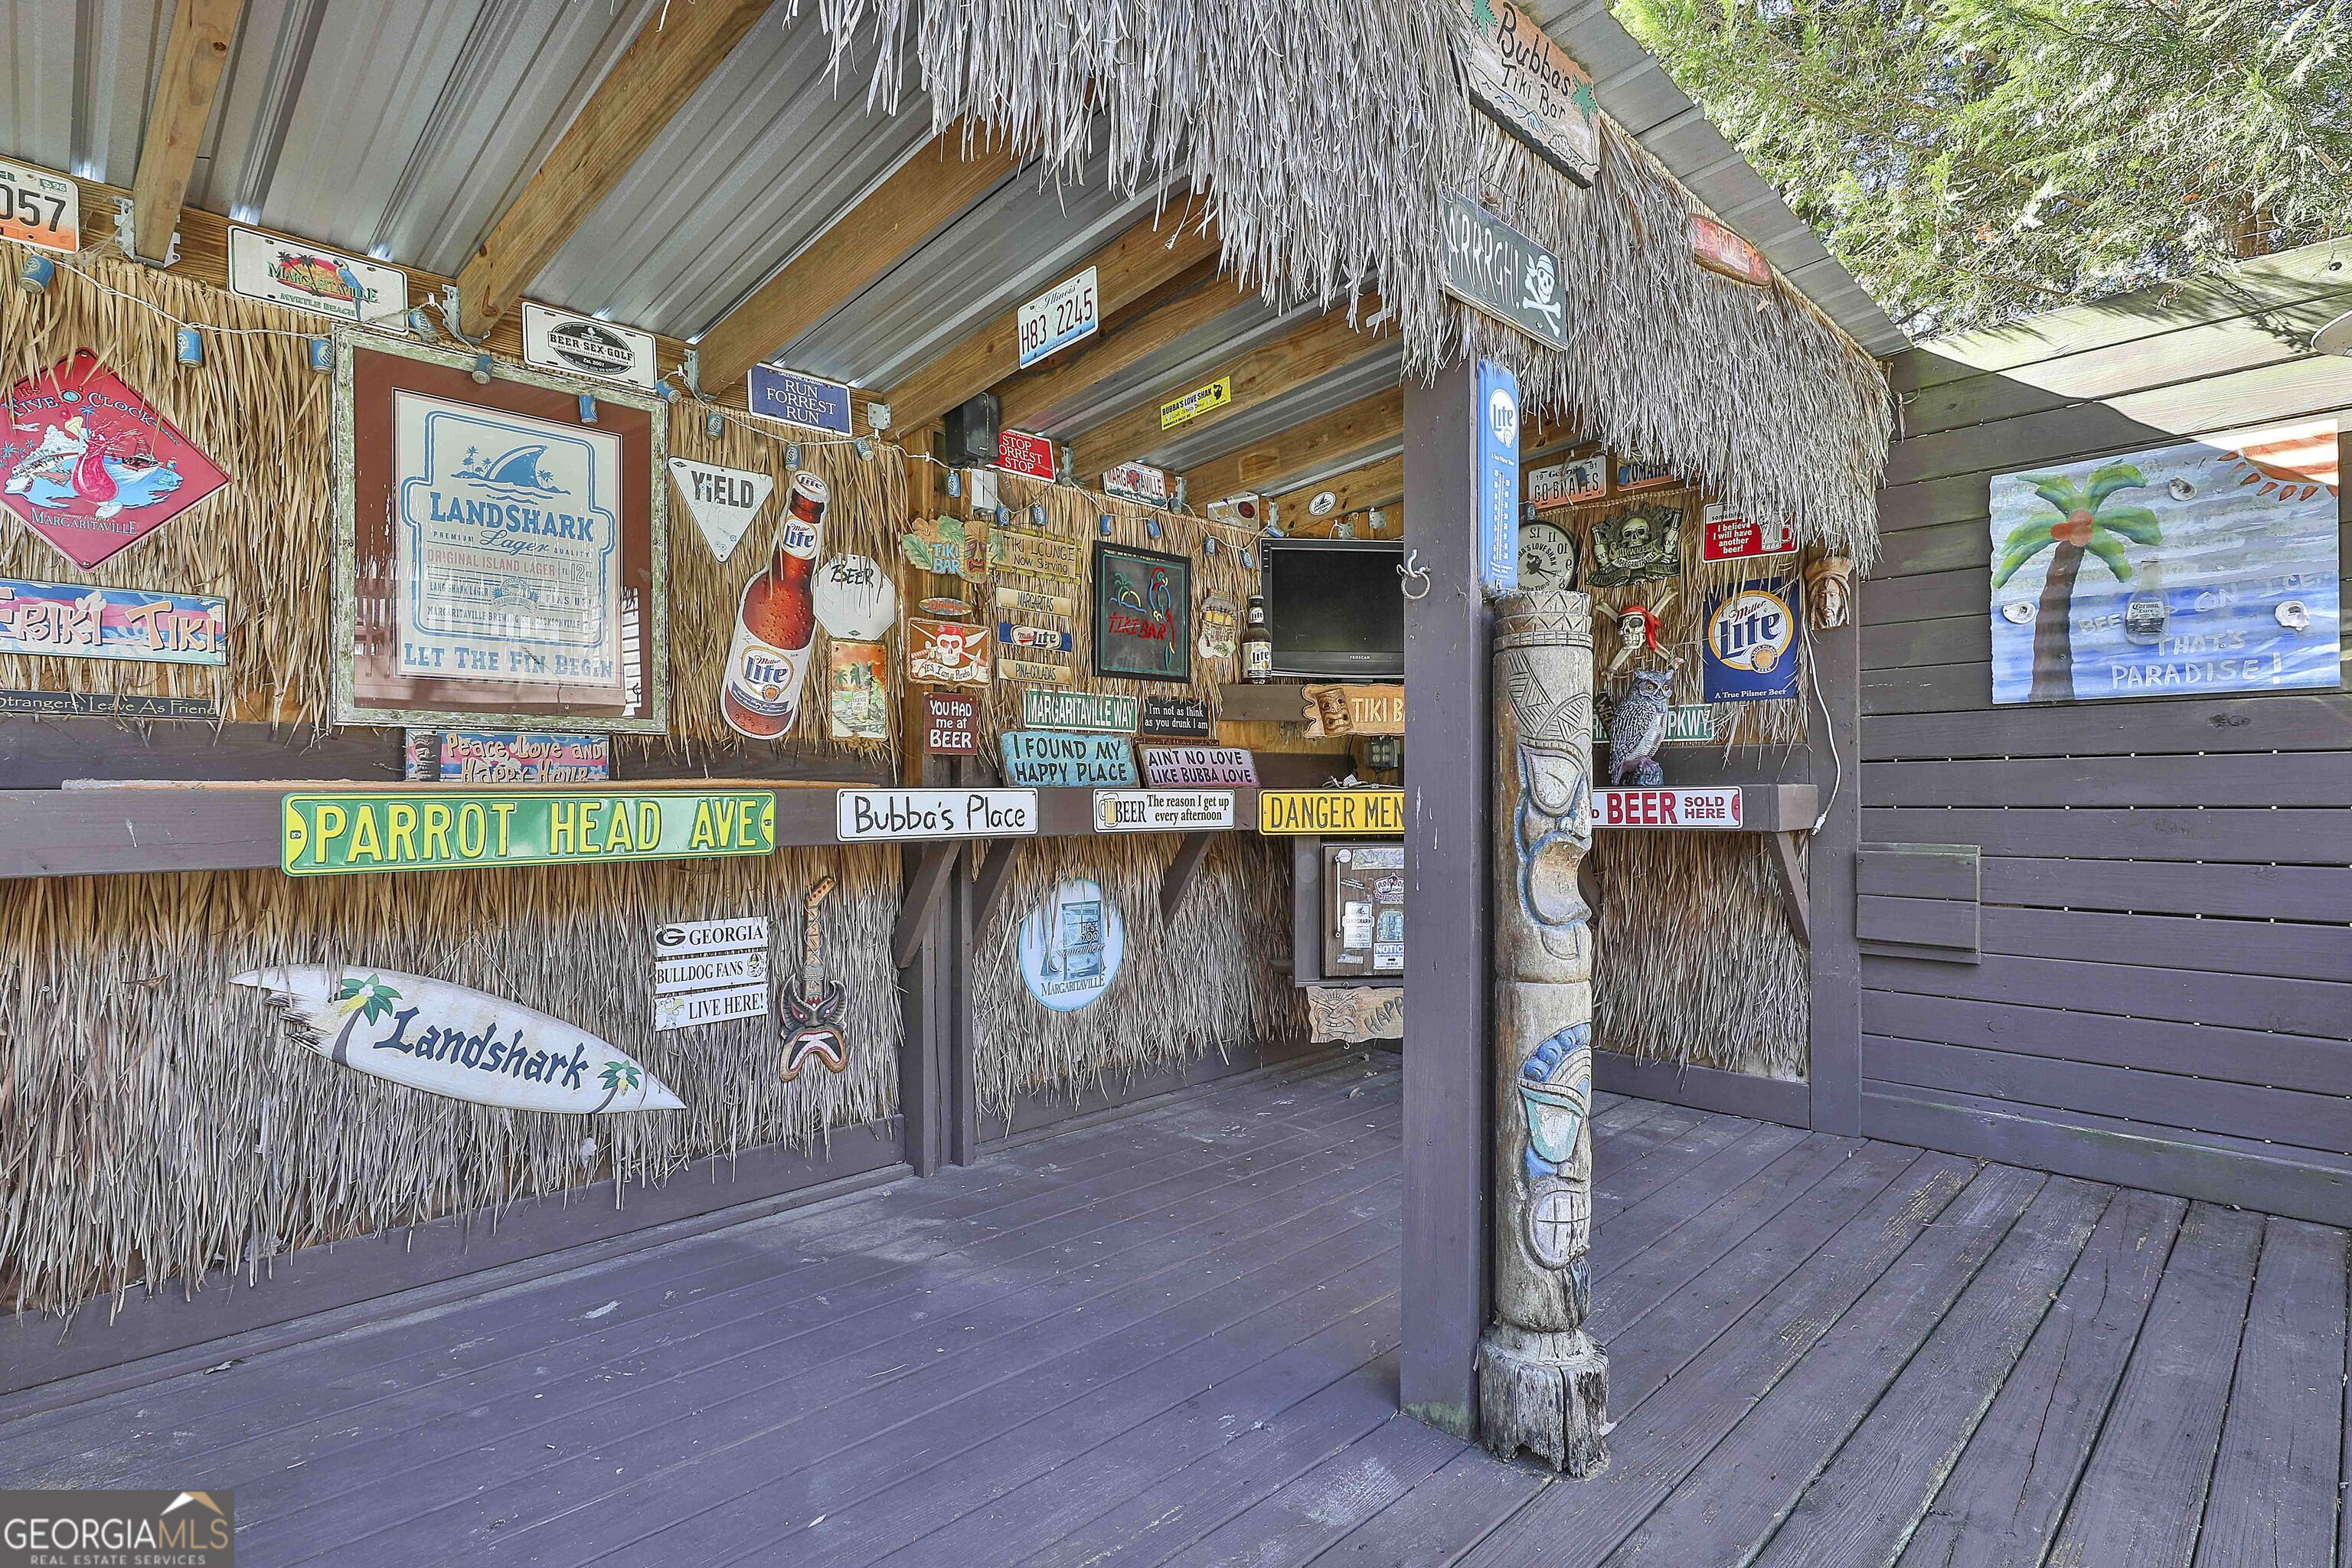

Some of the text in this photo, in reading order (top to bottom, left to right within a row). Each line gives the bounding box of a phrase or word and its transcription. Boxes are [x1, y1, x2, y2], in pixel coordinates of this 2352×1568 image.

[1497, 2, 1571, 96] Bubba's
[1501, 58, 1531, 99] Tiki
[1539, 84, 1566, 119] Bar
[279, 293, 355, 317] MYRTLE BEACH
[1035, 284, 1077, 312] Illinois
[1021, 287, 1093, 355] H83 2245
[785, 380, 818, 399] RUN
[766, 387, 838, 416] FORREST
[1162, 400, 1184, 416] BUBBA'S
[1184, 394, 1197, 407] LOVE
[1197, 387, 1212, 400] SHAK
[786, 405, 819, 425] RUN
[1492, 403, 1513, 433] Lite
[1002, 435, 1031, 450] STOP
[999, 444, 1043, 465] ORREST
[1005, 456, 1034, 472] STOP
[691, 470, 754, 508] YIELD
[799, 476, 823, 490] Lite
[1534, 483, 1548, 502] GO
[31, 507, 137, 534] MARGARITAVILLE
[429, 492, 594, 542] LANDSHARK
[433, 531, 474, 543] PREMIUM
[783, 524, 815, 549] Lite
[790, 524, 810, 533] Miller
[480, 530, 549, 556] Lager
[931, 542, 960, 559] TIKI
[1004, 537, 1076, 561] TIKI LOUNGE
[1719, 537, 1749, 547] another
[1723, 544, 1743, 554] beer!
[554, 548, 590, 558] QUALITY
[1014, 553, 1068, 573] Now Serving
[1532, 543, 1557, 566] LOVE SHAK
[427, 549, 586, 582] ORIGINAL ISLAND LAGER 12
[830, 562, 874, 588] BEER
[933, 557, 965, 575] BAR
[469, 584, 488, 596] LAGER
[929, 600, 962, 613] OPEN
[1018, 592, 1054, 611] MARGARITAS
[1728, 600, 1766, 623] Miller
[427, 606, 485, 620] MARGARITAVILLE
[1251, 611, 1263, 620] Lite
[126, 601, 217, 651] TIKI
[1109, 613, 1168, 640] TIKI BAR
[1719, 612, 1781, 659] Lite
[1034, 631, 1056, 647] Lite
[404, 643, 612, 678] LET THE FIN BEGIN
[754, 655, 781, 665] Miller
[1253, 652, 1269, 664] Lite
[743, 656, 788, 685] Lite
[936, 666, 942, 675] I
[90, 696, 165, 715] Leave As
[929, 700, 972, 717] YOU HAD
[1027, 694, 1135, 727] MARGARITAVILLE WAY
[1148, 704, 1204, 718] I'm not as think
[1351, 697, 1387, 723] TIKI
[936, 717, 967, 729] me at
[1145, 718, 1208, 731] as you drunk I am
[1668, 710, 1710, 737] PKWY
[517, 735, 564, 759] Love
[929, 730, 972, 749] BEER
[1013, 734, 1020, 760] I
[1026, 737, 1086, 760] FOUND
[1096, 740, 1121, 761] MY
[1148, 747, 1242, 767] AIN'T NO LOVE
[1014, 762, 1128, 782] HAPPY PLACE
[1151, 767, 1253, 784] LIKE BUBBA LOVE
[1116, 800, 1146, 823] BEER
[1147, 794, 1230, 811] The reason I get up
[1608, 792, 1677, 825] BEER
[1684, 796, 1725, 807] SOLD
[854, 794, 1026, 834] Bubba's Place
[1155, 808, 1222, 825] every afternoon
[1271, 797, 1404, 828] DANGER MEN
[1684, 808, 1726, 819] HERE
[314, 799, 759, 864] PARROT HEAD AVE
[689, 925, 764, 946] GEORGIA
[1376, 945, 1404, 953] NOTIC
[657, 960, 743, 984] BULLDOG FANS
[1040, 974, 1106, 997] MARGARITAVILLE
[689, 992, 764, 1019] LIVE HERE!
[372, 1005, 590, 1090] Landshark
